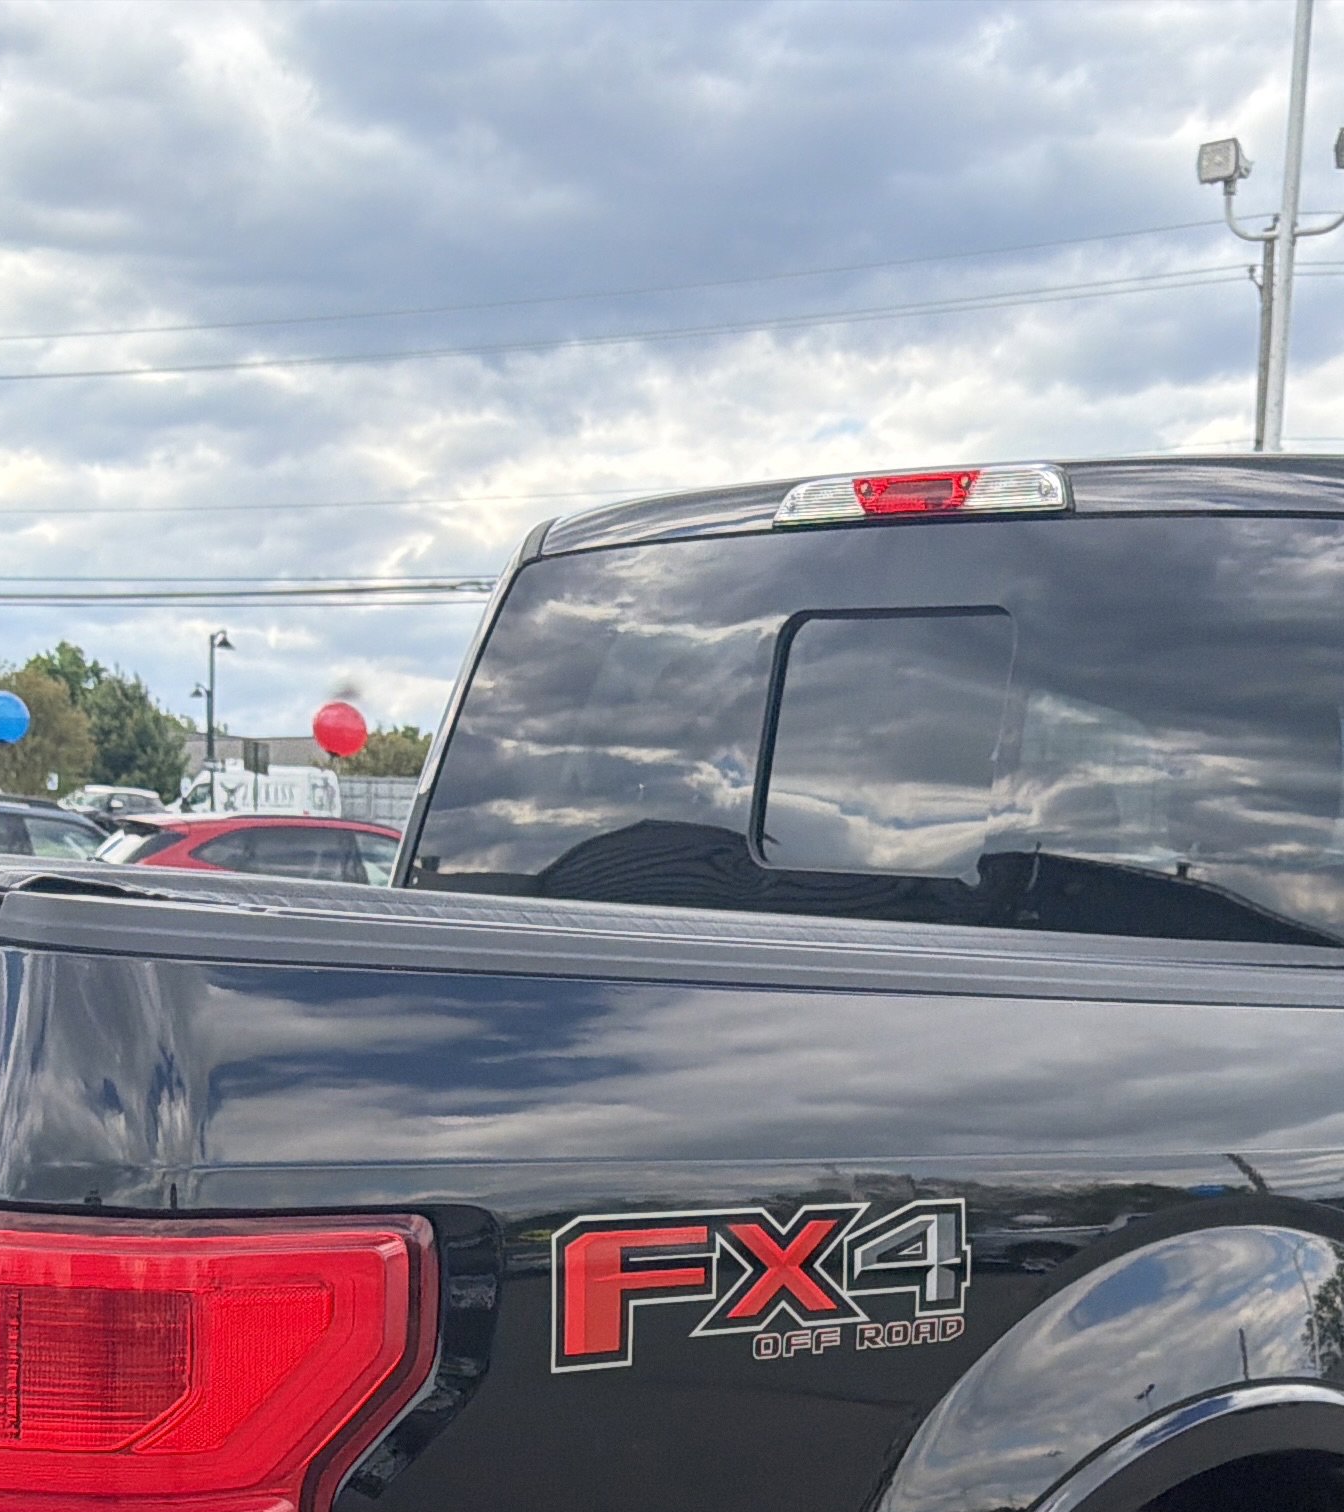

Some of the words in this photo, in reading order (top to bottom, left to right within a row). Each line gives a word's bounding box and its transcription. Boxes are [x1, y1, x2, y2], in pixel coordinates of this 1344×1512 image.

[551, 1198, 971, 1374] FX4
[753, 1327, 840, 1360] OFF
[856, 1316, 965, 1350] ROAD
